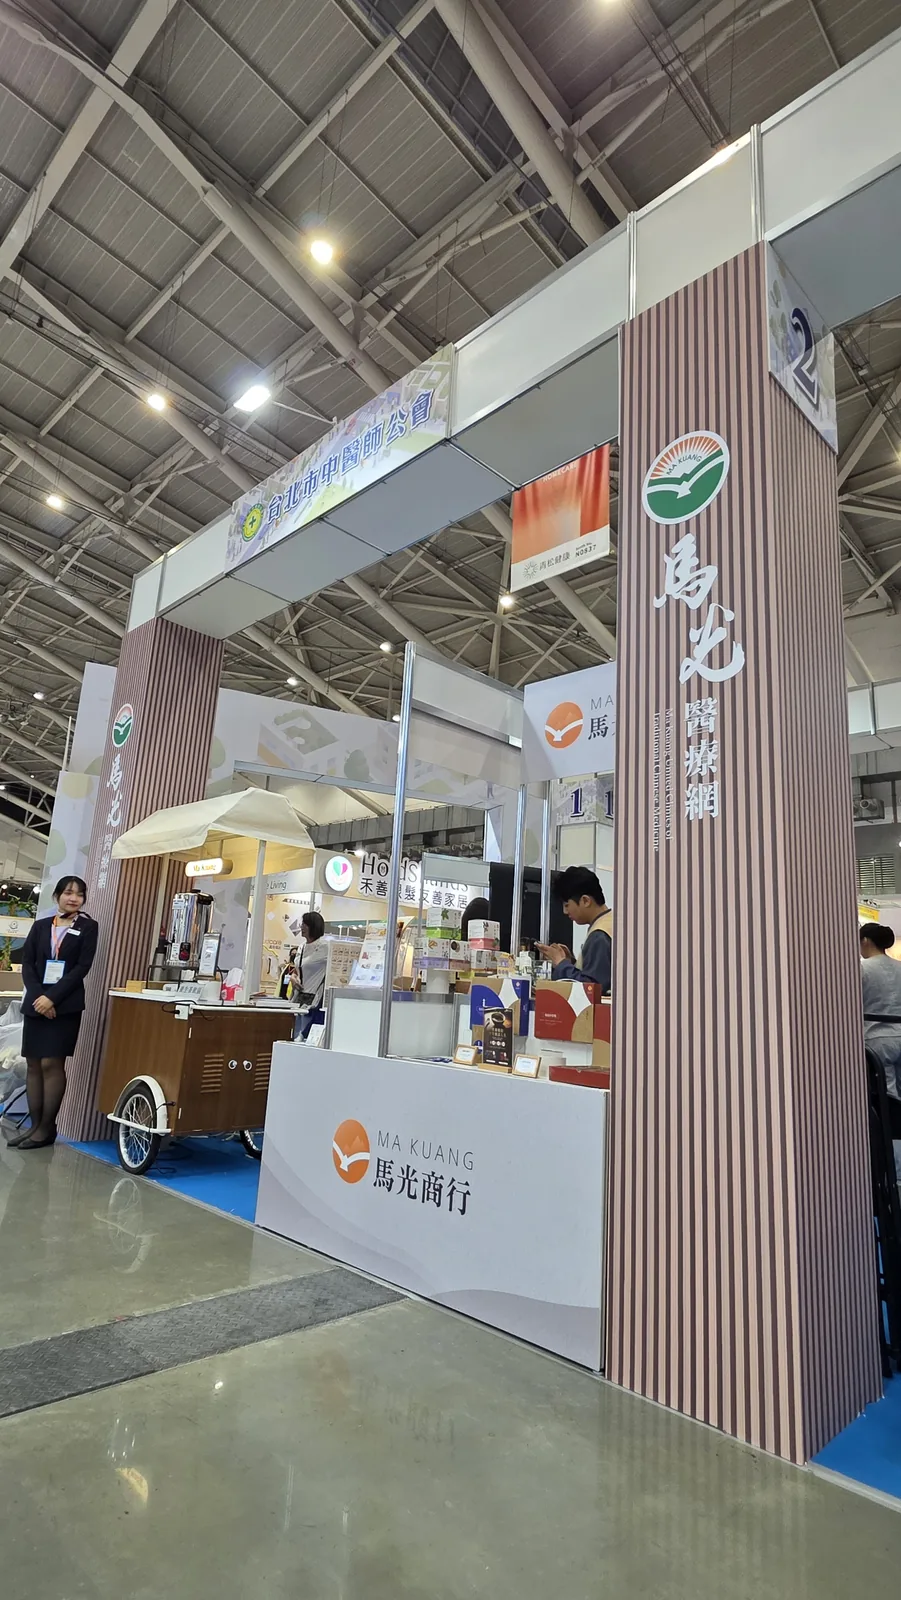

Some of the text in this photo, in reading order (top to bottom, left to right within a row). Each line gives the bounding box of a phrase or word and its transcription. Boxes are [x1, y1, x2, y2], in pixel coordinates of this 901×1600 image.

[790, 307, 819, 411] 2
[266, 388, 435, 525] 台北市中醫師公會
[666, 454, 702, 475] MA KUANG
[590, 694, 614, 710] MA
[588, 714, 616, 741] 馬
[684, 697, 720, 821] 醫療網
[570, 787, 584, 818] 1
[269, 880, 287, 891] Living
[377, 1130, 474, 1171] MA KUANG
[373, 1156, 471, 1216] 馬光商行
